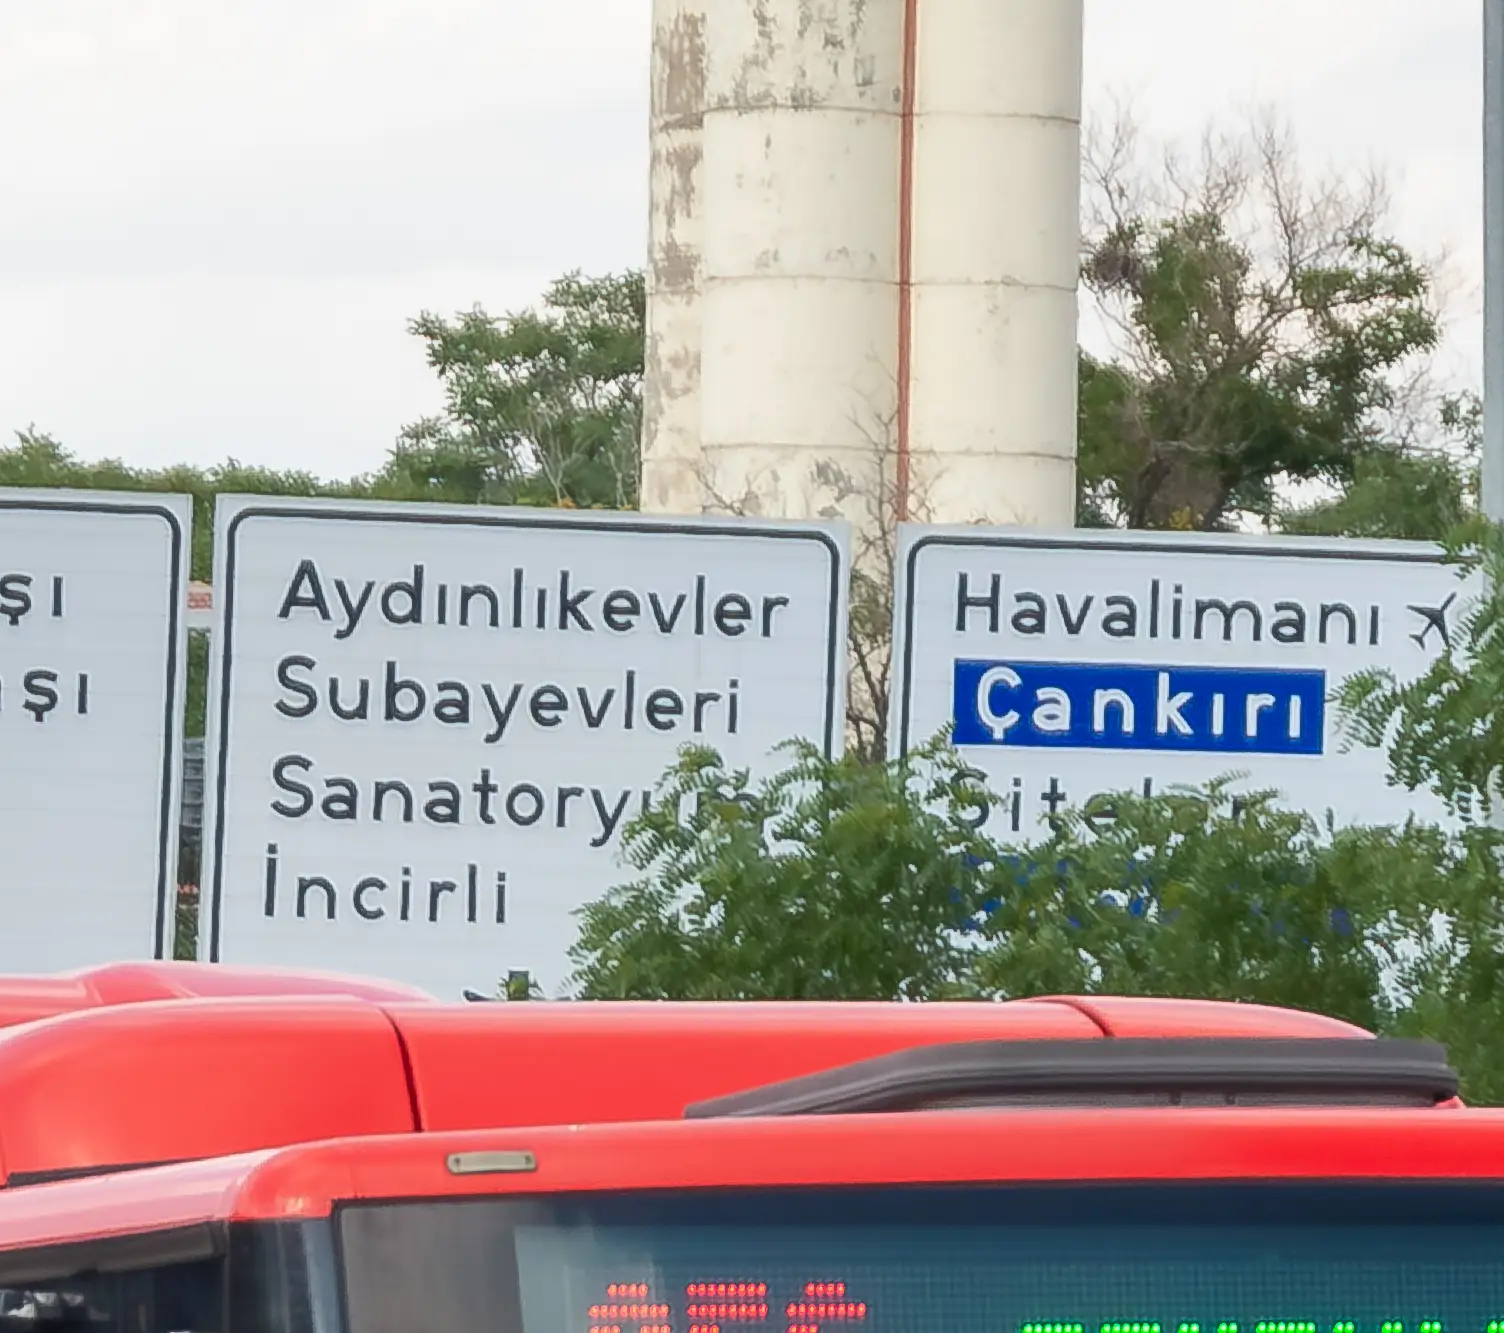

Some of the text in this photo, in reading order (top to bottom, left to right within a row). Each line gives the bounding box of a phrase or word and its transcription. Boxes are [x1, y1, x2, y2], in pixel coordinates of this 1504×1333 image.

[278, 558, 791, 641] Aydınlıkevler
[954, 571, 1380, 646] Havalimanı
[274, 654, 740, 744] Subayevleri
[976, 665, 1303, 741] Çankırı
[263, 842, 508, 925] İncirli
